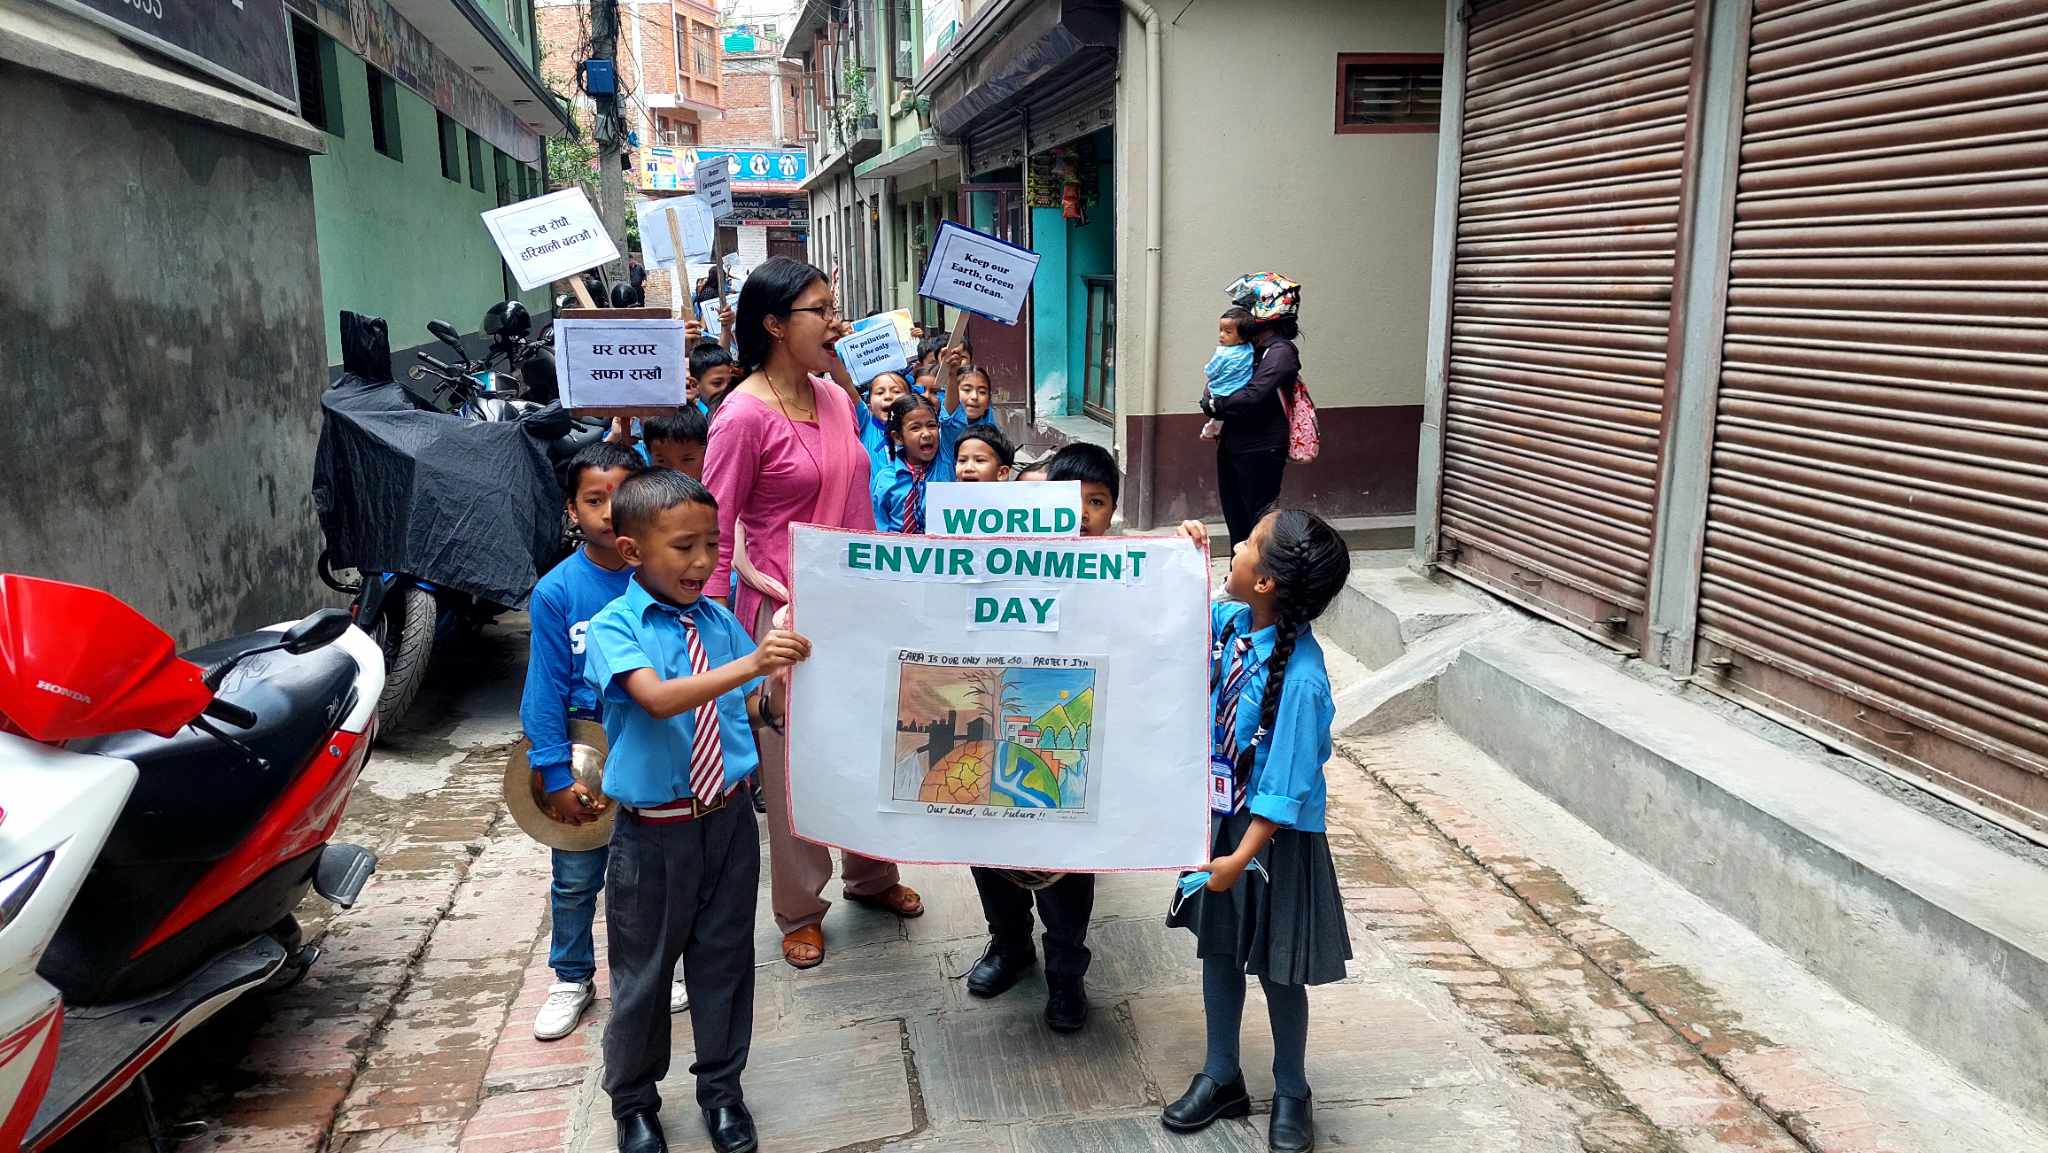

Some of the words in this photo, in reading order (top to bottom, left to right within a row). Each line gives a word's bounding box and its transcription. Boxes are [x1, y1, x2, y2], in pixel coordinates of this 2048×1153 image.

[520, 239, 561, 261] हरियाली
[965, 253, 989, 268] Keep
[991, 264, 1010, 274] our
[951, 262, 982, 280] Earth,
[985, 273, 1014, 290] Green
[953, 278, 972, 288] and
[974, 283, 1004, 299] Clean.
[592, 344, 613, 355] घर
[618, 344, 657, 355] वरपर
[849, 343, 859, 351] No
[860, 332, 890, 348] pollution
[863, 347, 875, 357] the
[875, 342, 889, 353] only
[862, 353, 890, 366] solution.
[590, 369, 624, 380] सफा
[943, 507, 1076, 534] WORLD
[974, 597, 1056, 624] DAY
[928, 655, 938, 663] IS
[941, 656, 959, 665] OUR
[962, 656, 981, 665] ONLY
[986, 657, 1006, 665] HOME
[1032, 656, 1068, 667] PROTECT
[36, 680, 91, 704] HONDA
[927, 804, 946, 814] Our
[948, 805, 977, 817] Land,
[982, 808, 997, 816] Our
